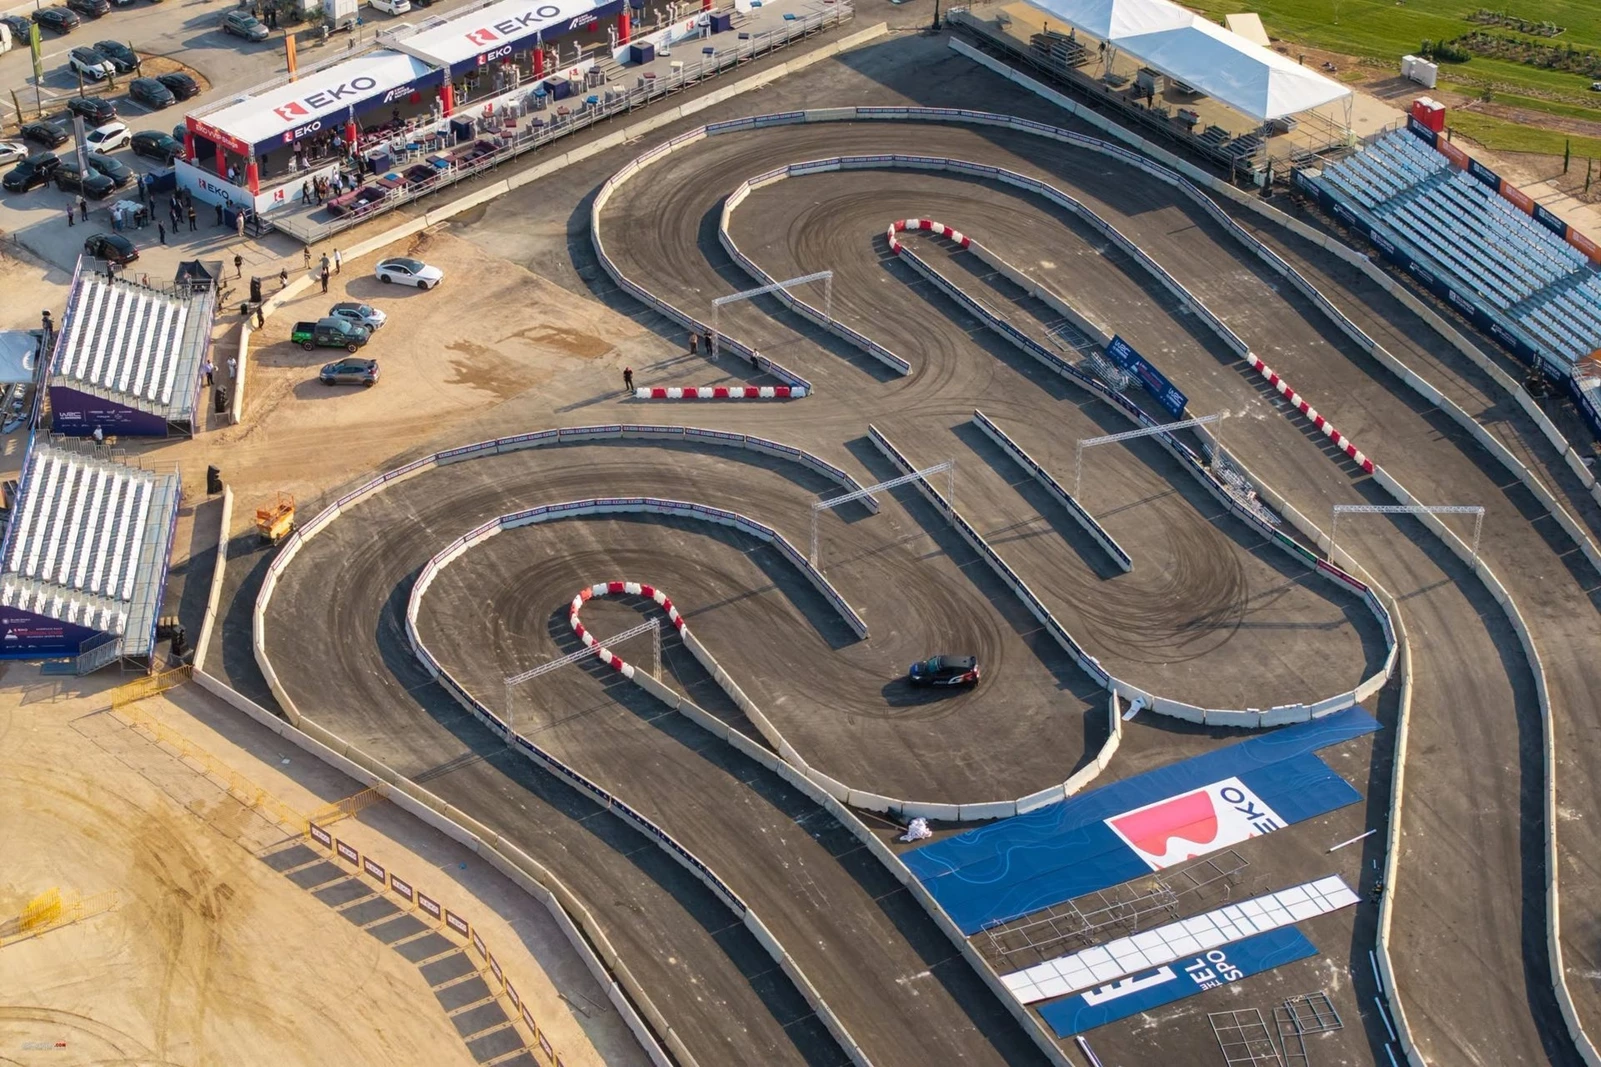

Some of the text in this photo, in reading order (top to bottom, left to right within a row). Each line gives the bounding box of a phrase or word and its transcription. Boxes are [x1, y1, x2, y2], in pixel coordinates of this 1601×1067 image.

[494, 5, 560, 35] EKO
[487, 45, 512, 61] EKO
[304, 77, 376, 109] EKO
[295, 121, 321, 138] EKO
[207, 183, 229, 199] EKO
[1220, 787, 1280, 834] EKO
